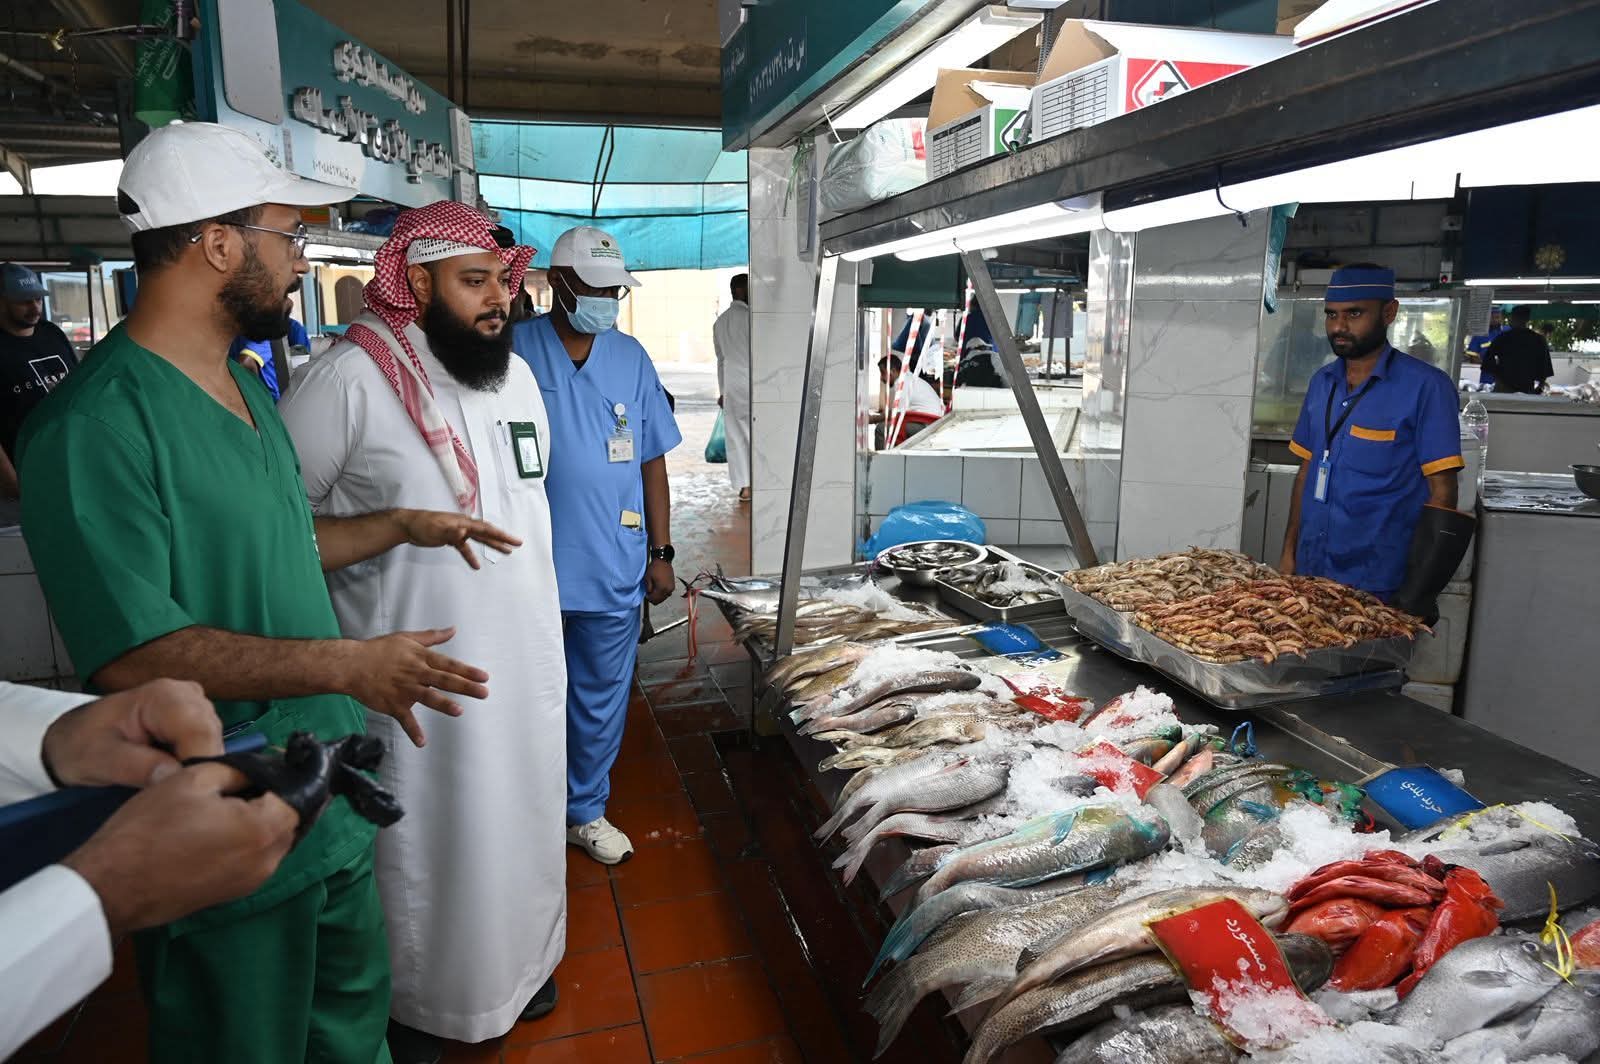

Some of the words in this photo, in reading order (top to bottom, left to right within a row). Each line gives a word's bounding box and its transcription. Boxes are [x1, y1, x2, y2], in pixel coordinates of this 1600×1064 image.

[1400, 782, 1423, 798] بلدي
[1420, 797, 1442, 813] حريد
[1226, 918, 1267, 972] مستورد
